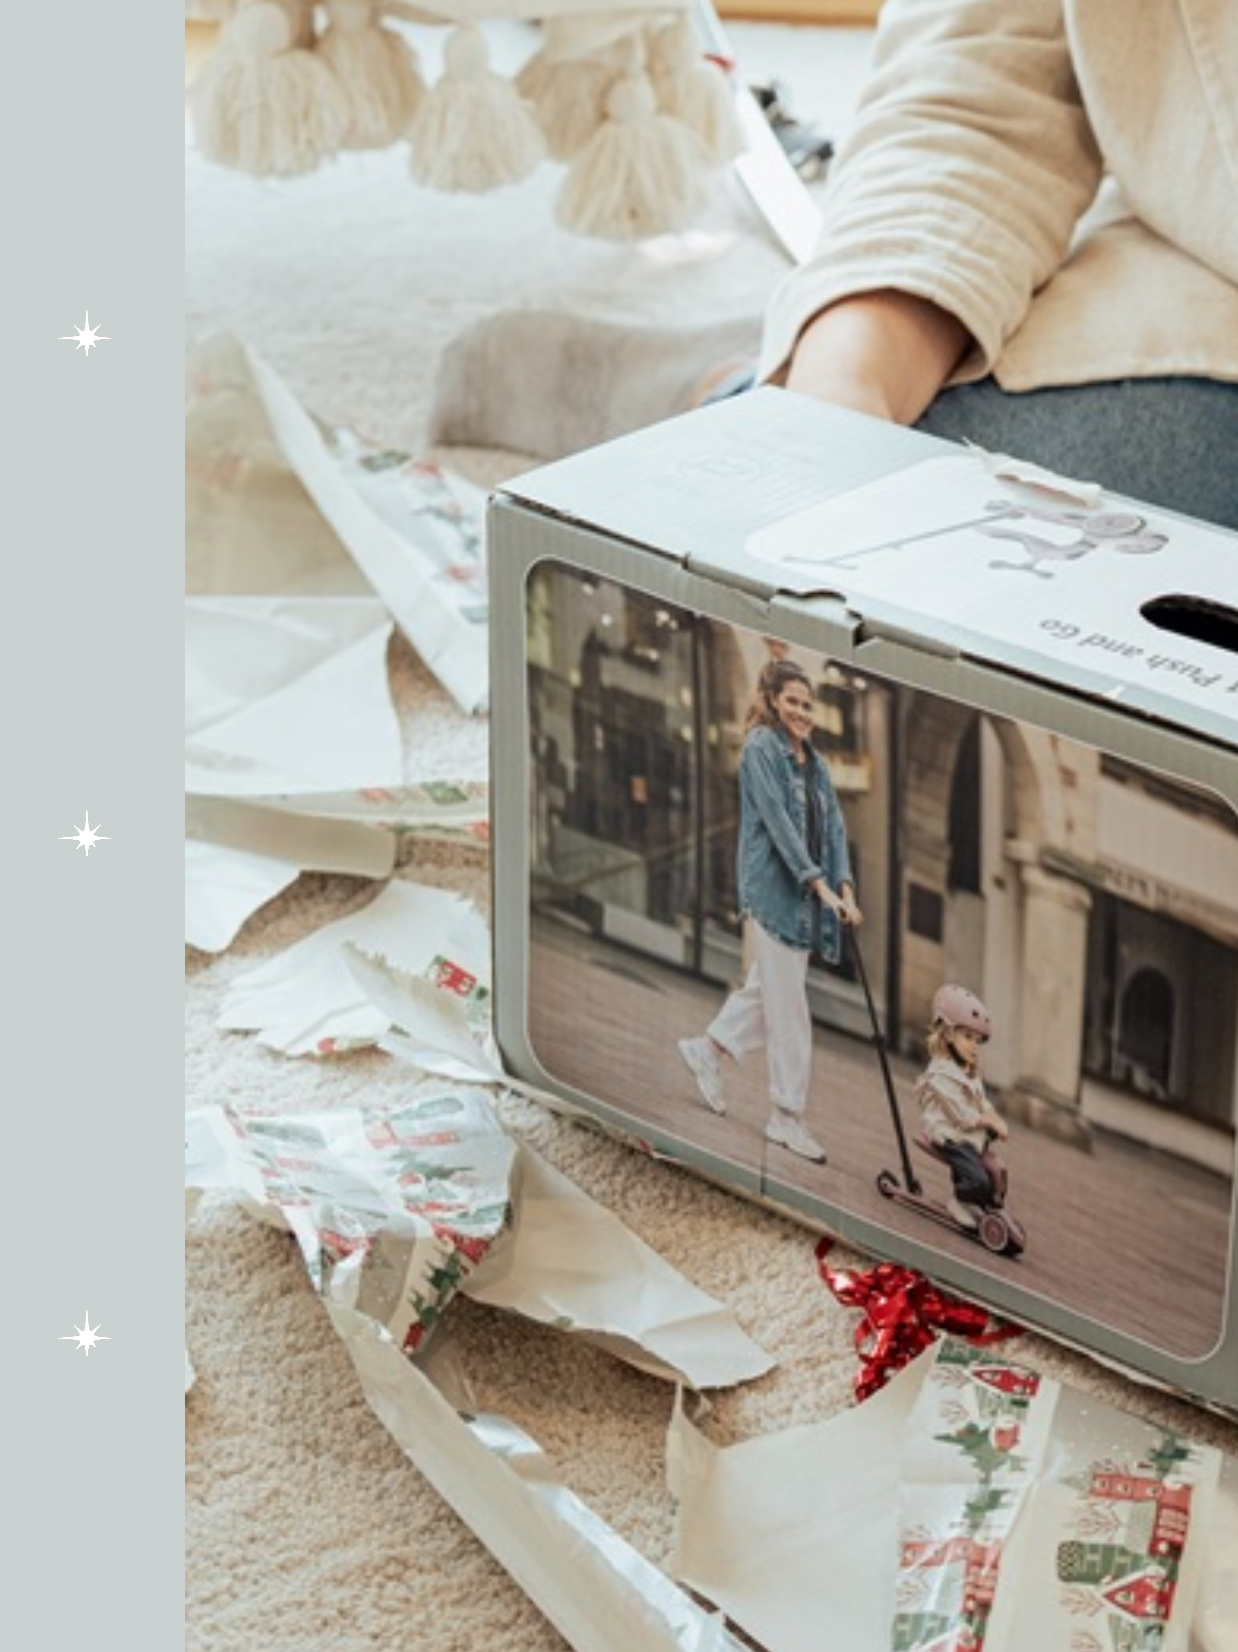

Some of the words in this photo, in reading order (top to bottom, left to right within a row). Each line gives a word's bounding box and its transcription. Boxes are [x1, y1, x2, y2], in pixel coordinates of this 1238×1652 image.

[1039, 618, 1080, 638] Go
[1079, 634, 1145, 659] and
[1148, 655, 1222, 688] Push
